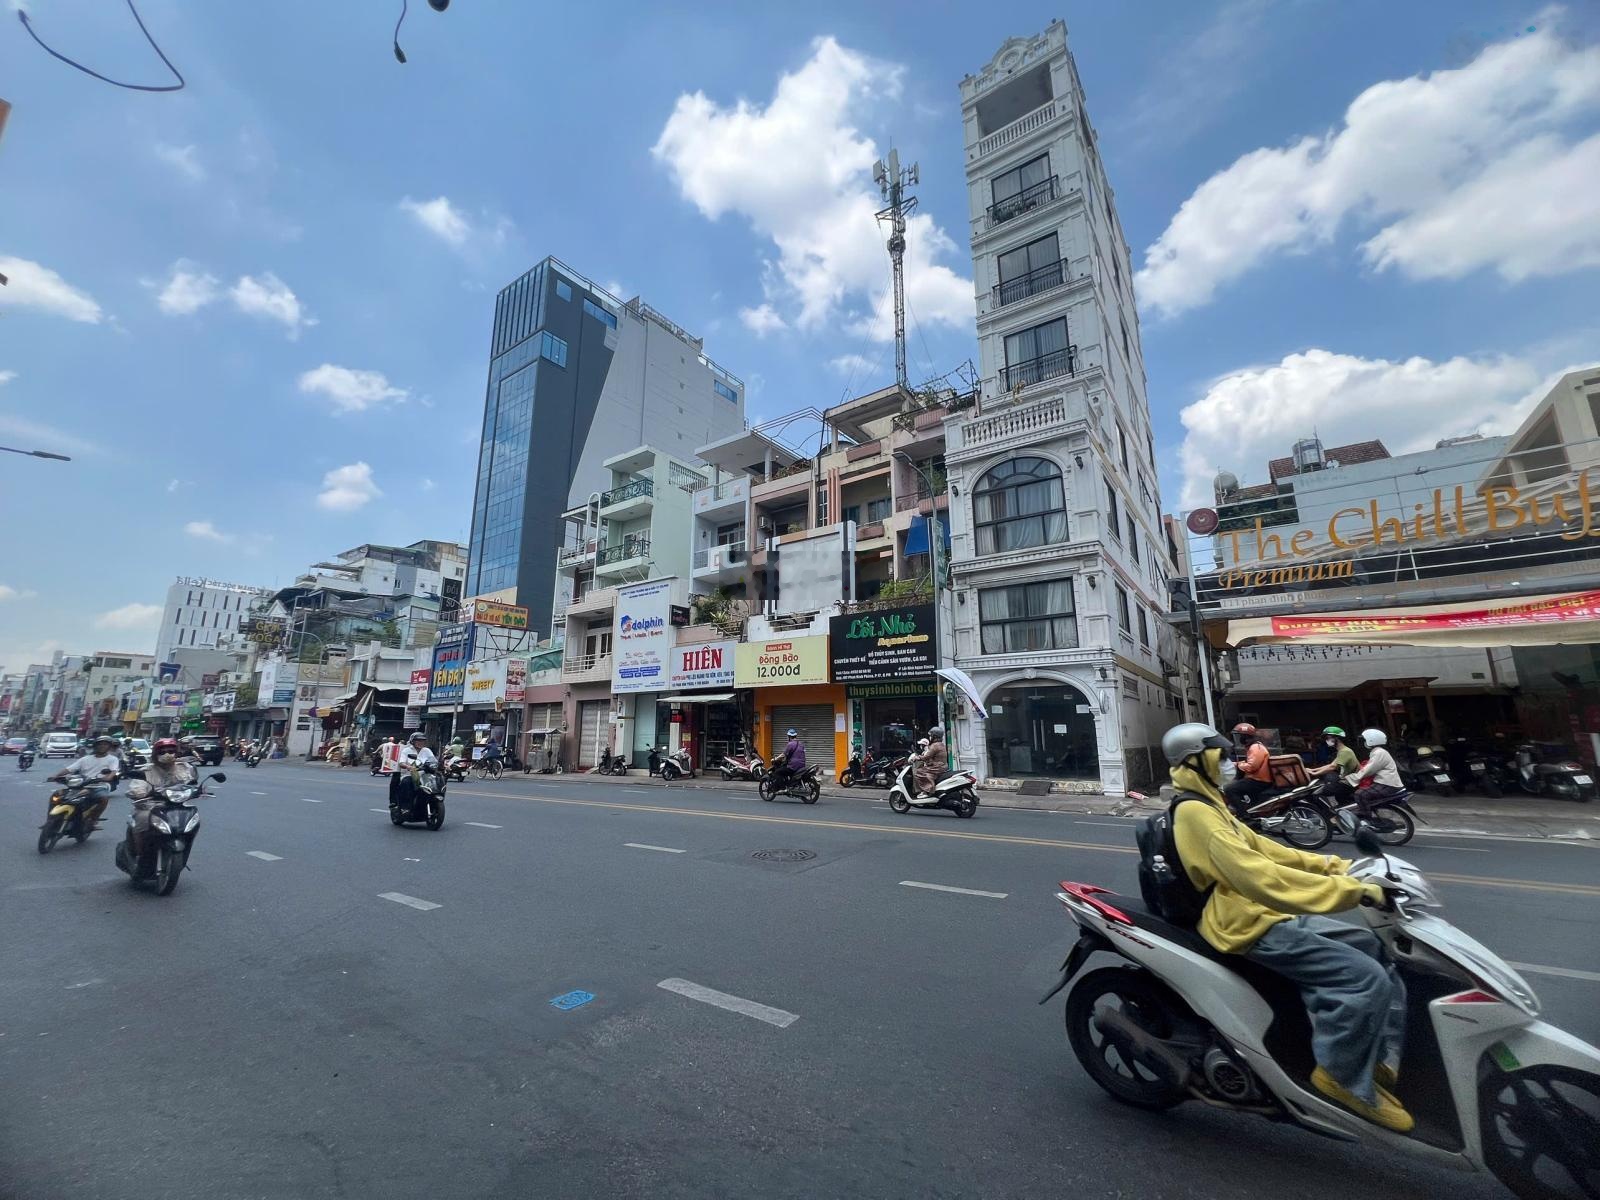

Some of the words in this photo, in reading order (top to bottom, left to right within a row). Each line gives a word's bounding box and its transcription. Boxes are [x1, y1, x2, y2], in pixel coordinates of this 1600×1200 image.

[1219, 517, 1312, 564] The
[1327, 484, 1468, 549] Chill
[1218, 560, 1355, 590] Premium
[631, 615, 665, 632] dolphin
[682, 645, 723, 672] HIỀN
[757, 664, 801, 678] 12.000đ
[849, 682, 944, 698] thuysinhloinho.c
